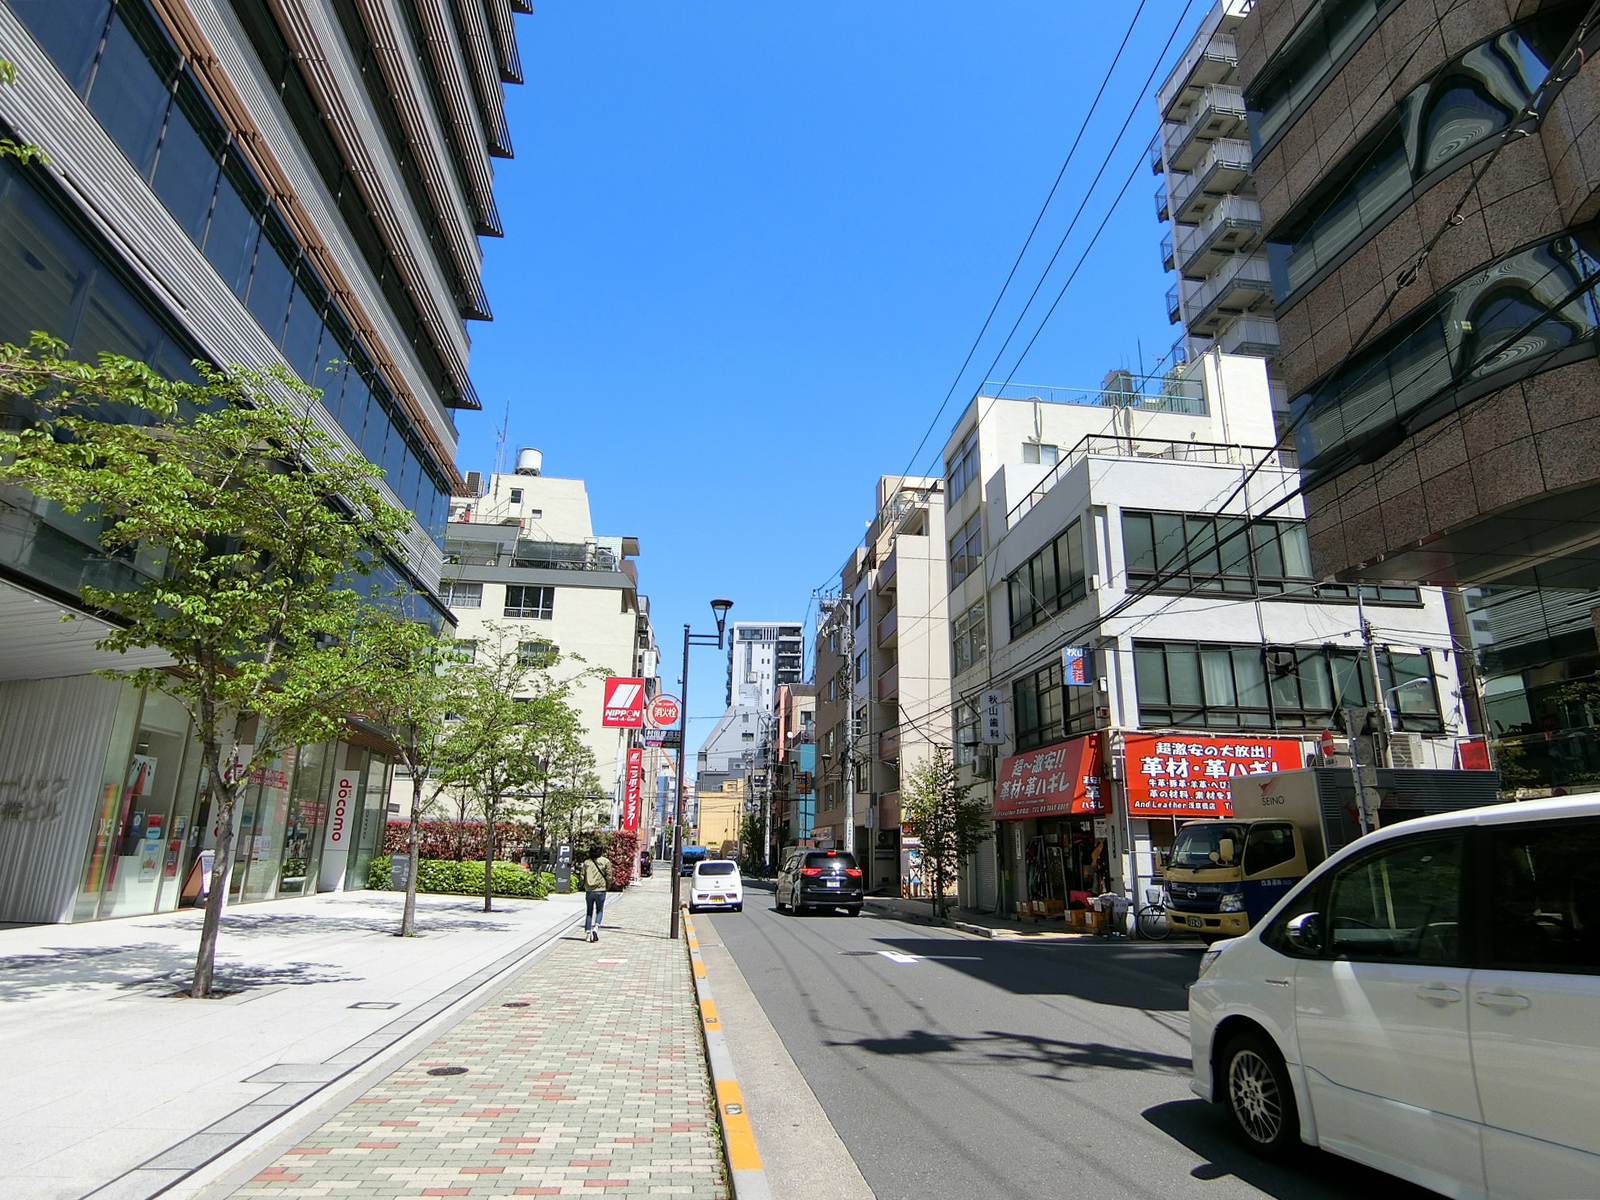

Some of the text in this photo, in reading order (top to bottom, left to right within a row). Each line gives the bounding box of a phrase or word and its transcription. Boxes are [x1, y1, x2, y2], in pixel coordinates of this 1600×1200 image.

[605, 709, 641, 717] NIPPON
[654, 707, 677, 718] 消火栓
[988, 694, 999, 740] 秋山歯科
[627, 765, 639, 826] ニッポンレンタカー
[1085, 786, 1101, 799] 革
[1134, 800, 1150, 809] And
[1152, 801, 1187, 811] Leather
[1261, 796, 1285, 806] SEINO
[332, 778, 353, 842] docomo
[560, 845, 570, 856] P
